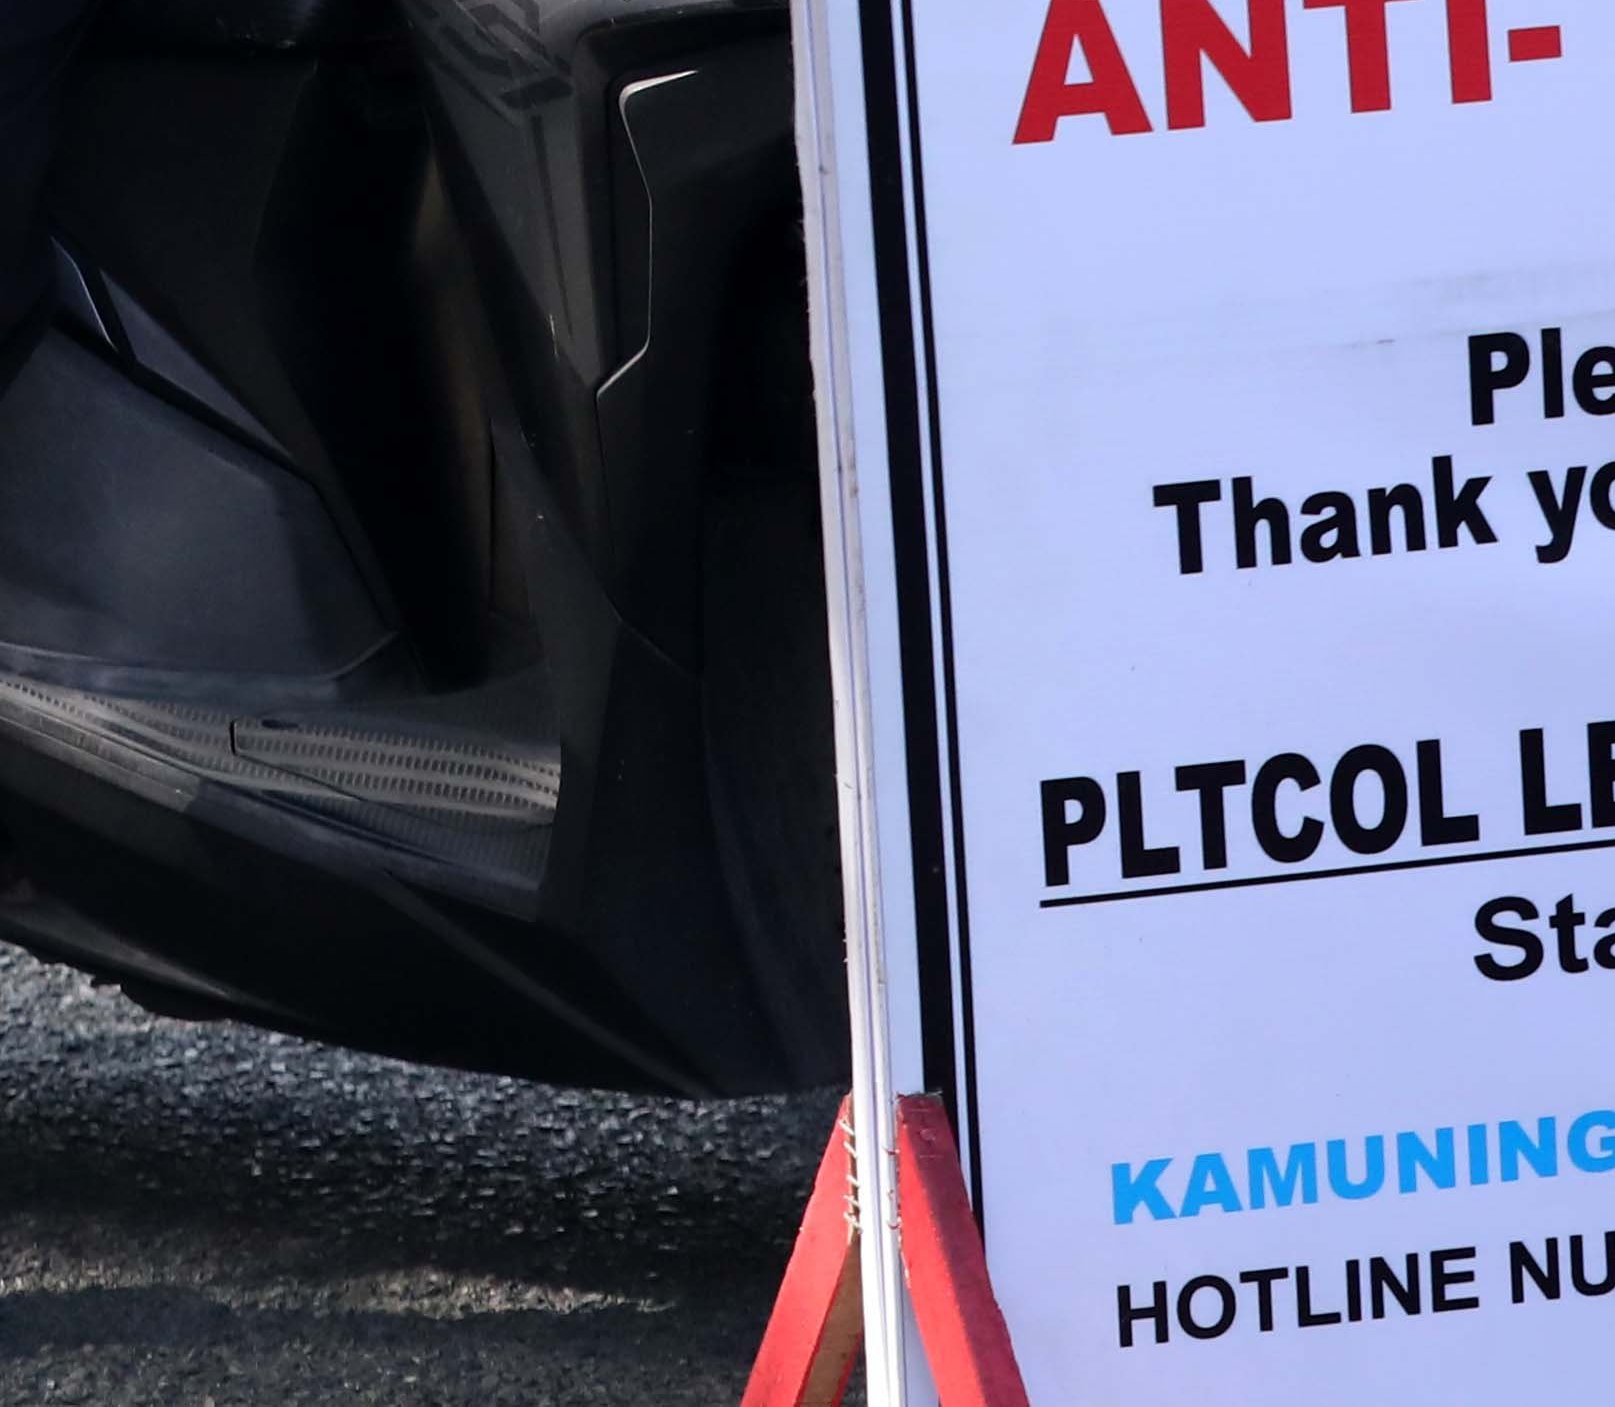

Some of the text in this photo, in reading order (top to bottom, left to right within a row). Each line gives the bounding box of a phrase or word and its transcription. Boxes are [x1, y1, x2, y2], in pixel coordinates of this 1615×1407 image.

[1153, 455, 1498, 574] Thank
[1041, 739, 1479, 886] PLTCOL
[1117, 1247, 1479, 1347] HOTLINE
